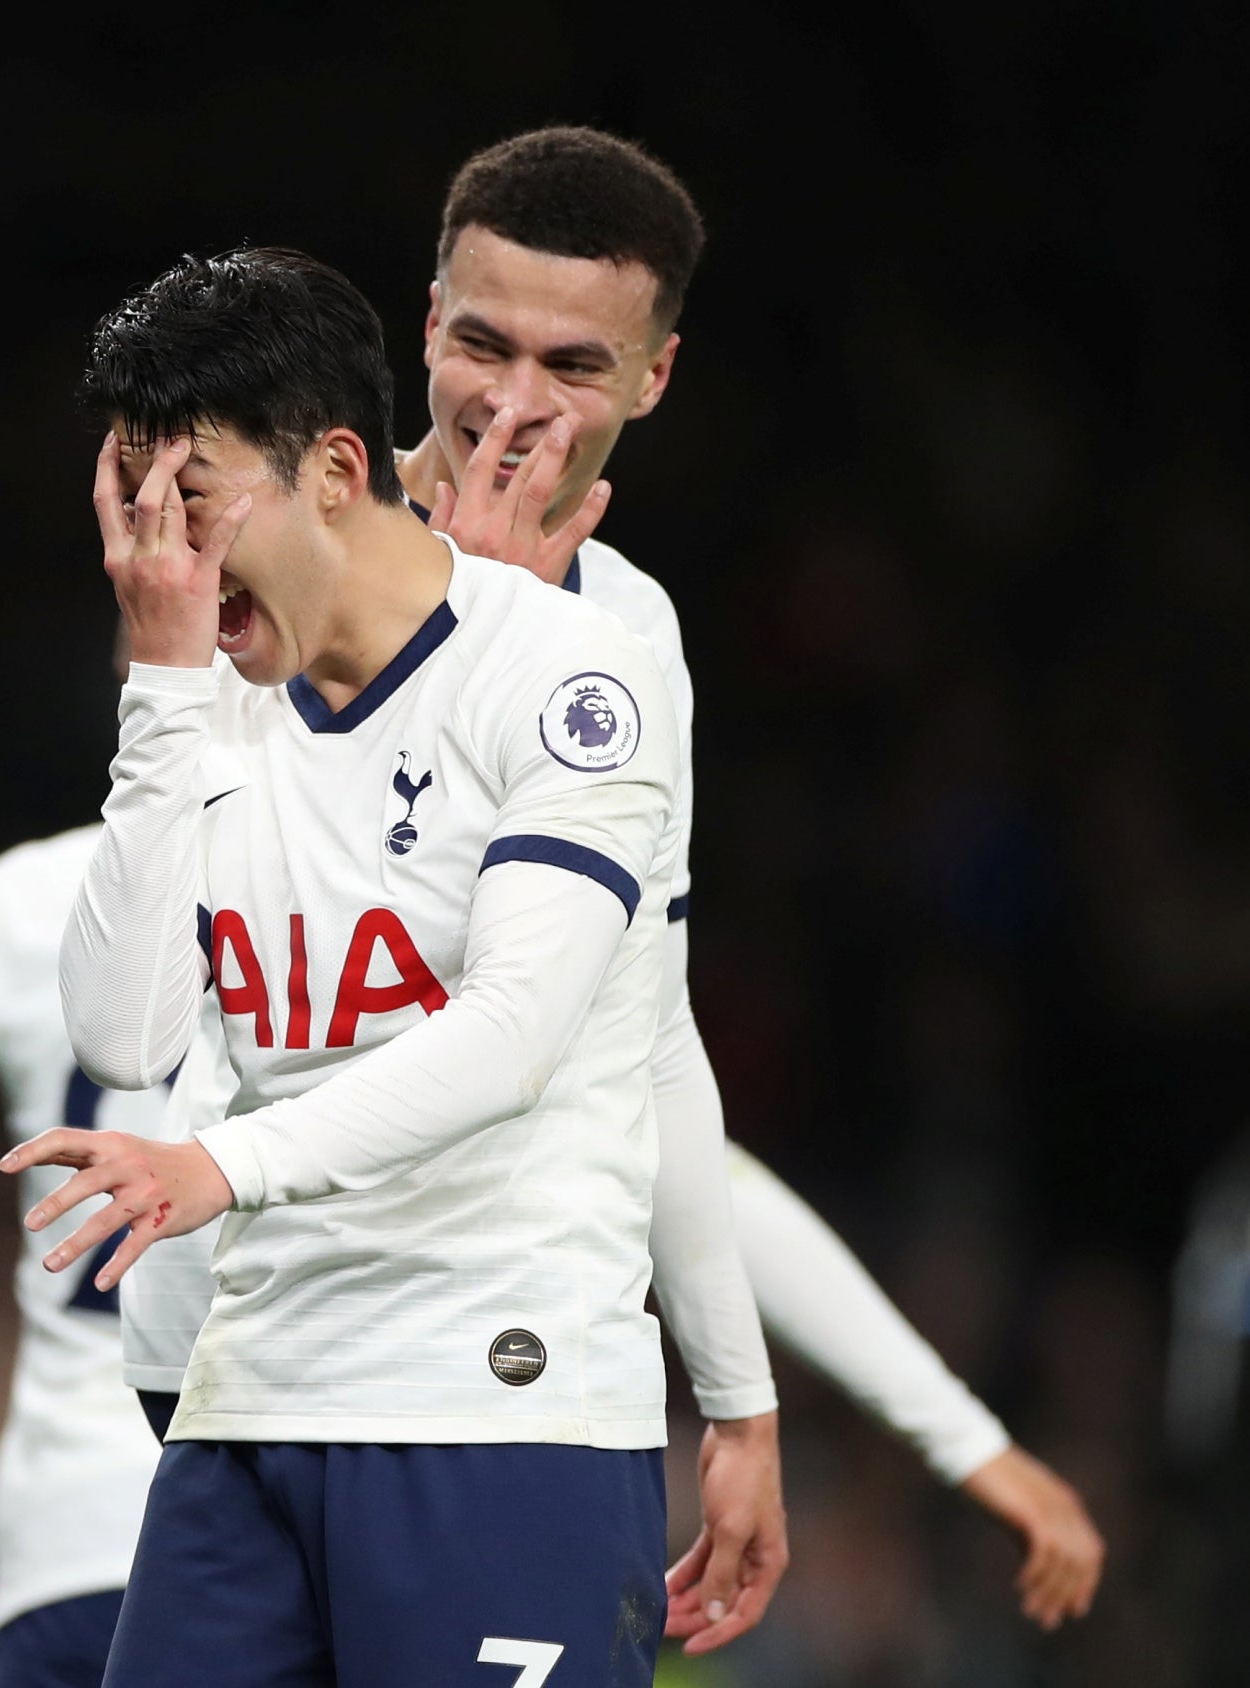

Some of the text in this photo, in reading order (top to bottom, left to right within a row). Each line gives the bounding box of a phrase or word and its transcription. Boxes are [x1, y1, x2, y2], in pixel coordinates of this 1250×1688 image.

[586, 721, 632, 763] Premier League
[212, 908, 450, 1049] AIA
